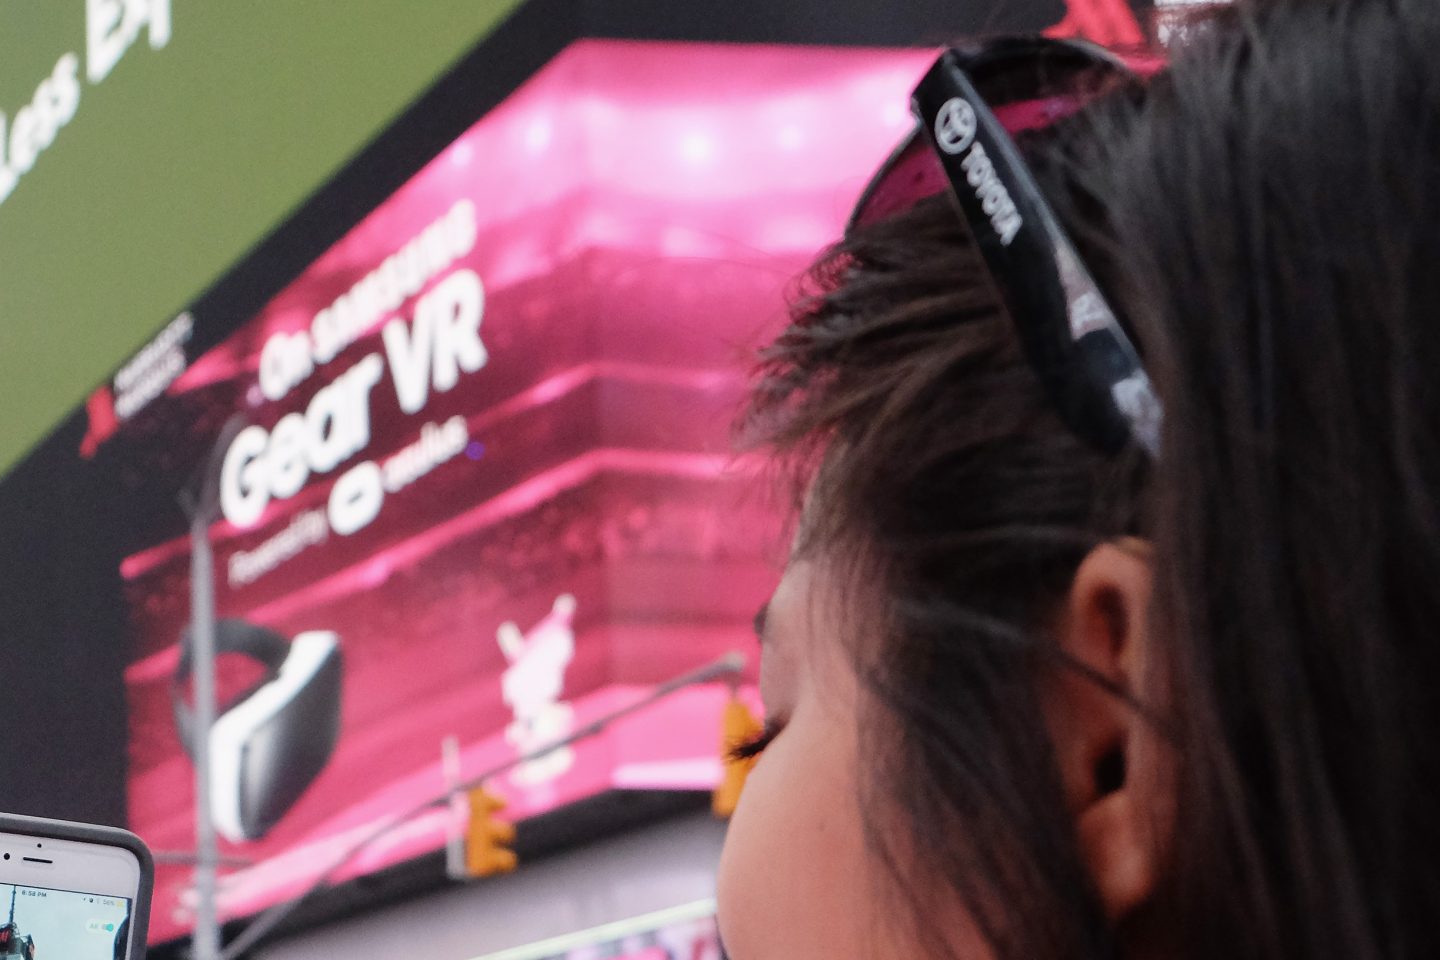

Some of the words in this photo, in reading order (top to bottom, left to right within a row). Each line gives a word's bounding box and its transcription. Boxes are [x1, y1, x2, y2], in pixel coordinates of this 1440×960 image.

[961, 141, 1023, 246] TOYOTA
[220, 353, 383, 529] Gear
[381, 269, 488, 415] VR
